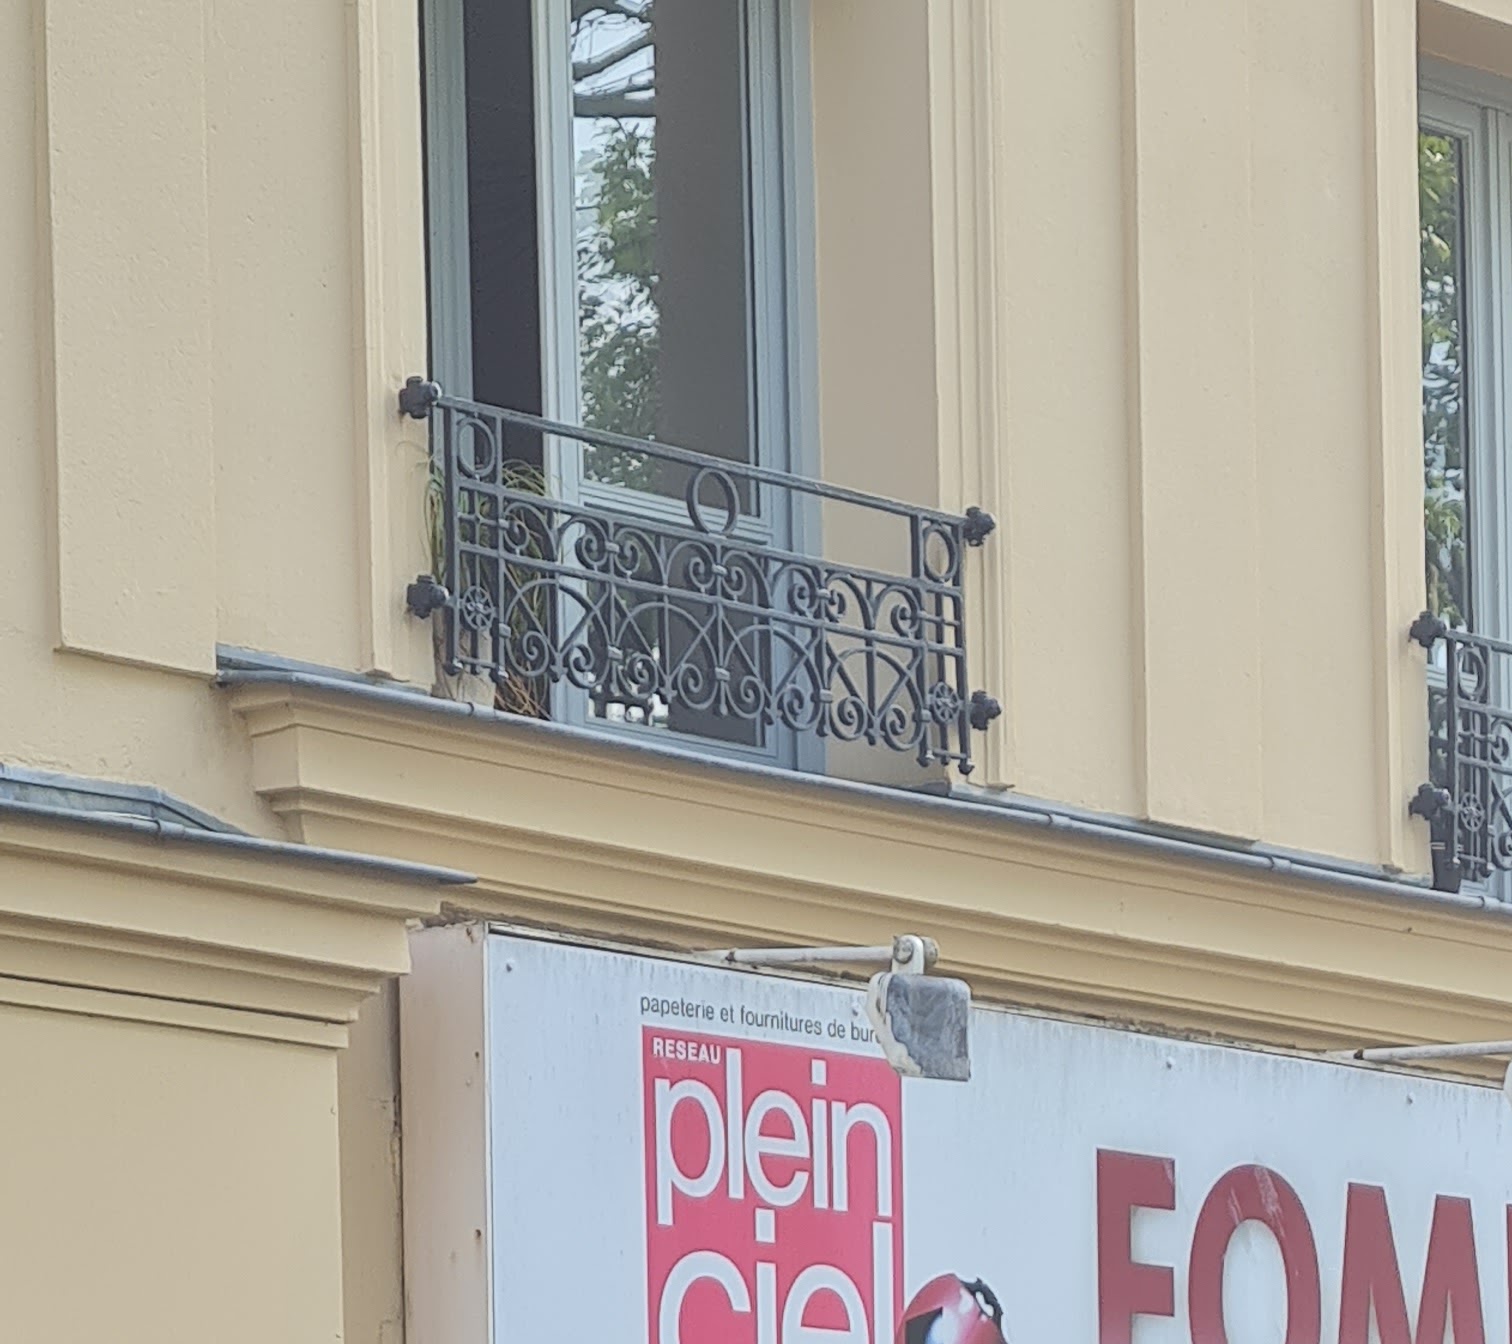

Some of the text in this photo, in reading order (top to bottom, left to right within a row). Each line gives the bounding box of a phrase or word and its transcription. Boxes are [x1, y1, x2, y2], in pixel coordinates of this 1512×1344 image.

[640, 995, 715, 1022] papeterie
[719, 1005, 735, 1024] et
[740, 1004, 823, 1036] fournitures
[827, 1018, 846, 1039] de
[652, 1036, 721, 1065] RESEAU
[653, 1045, 893, 1227] plein
